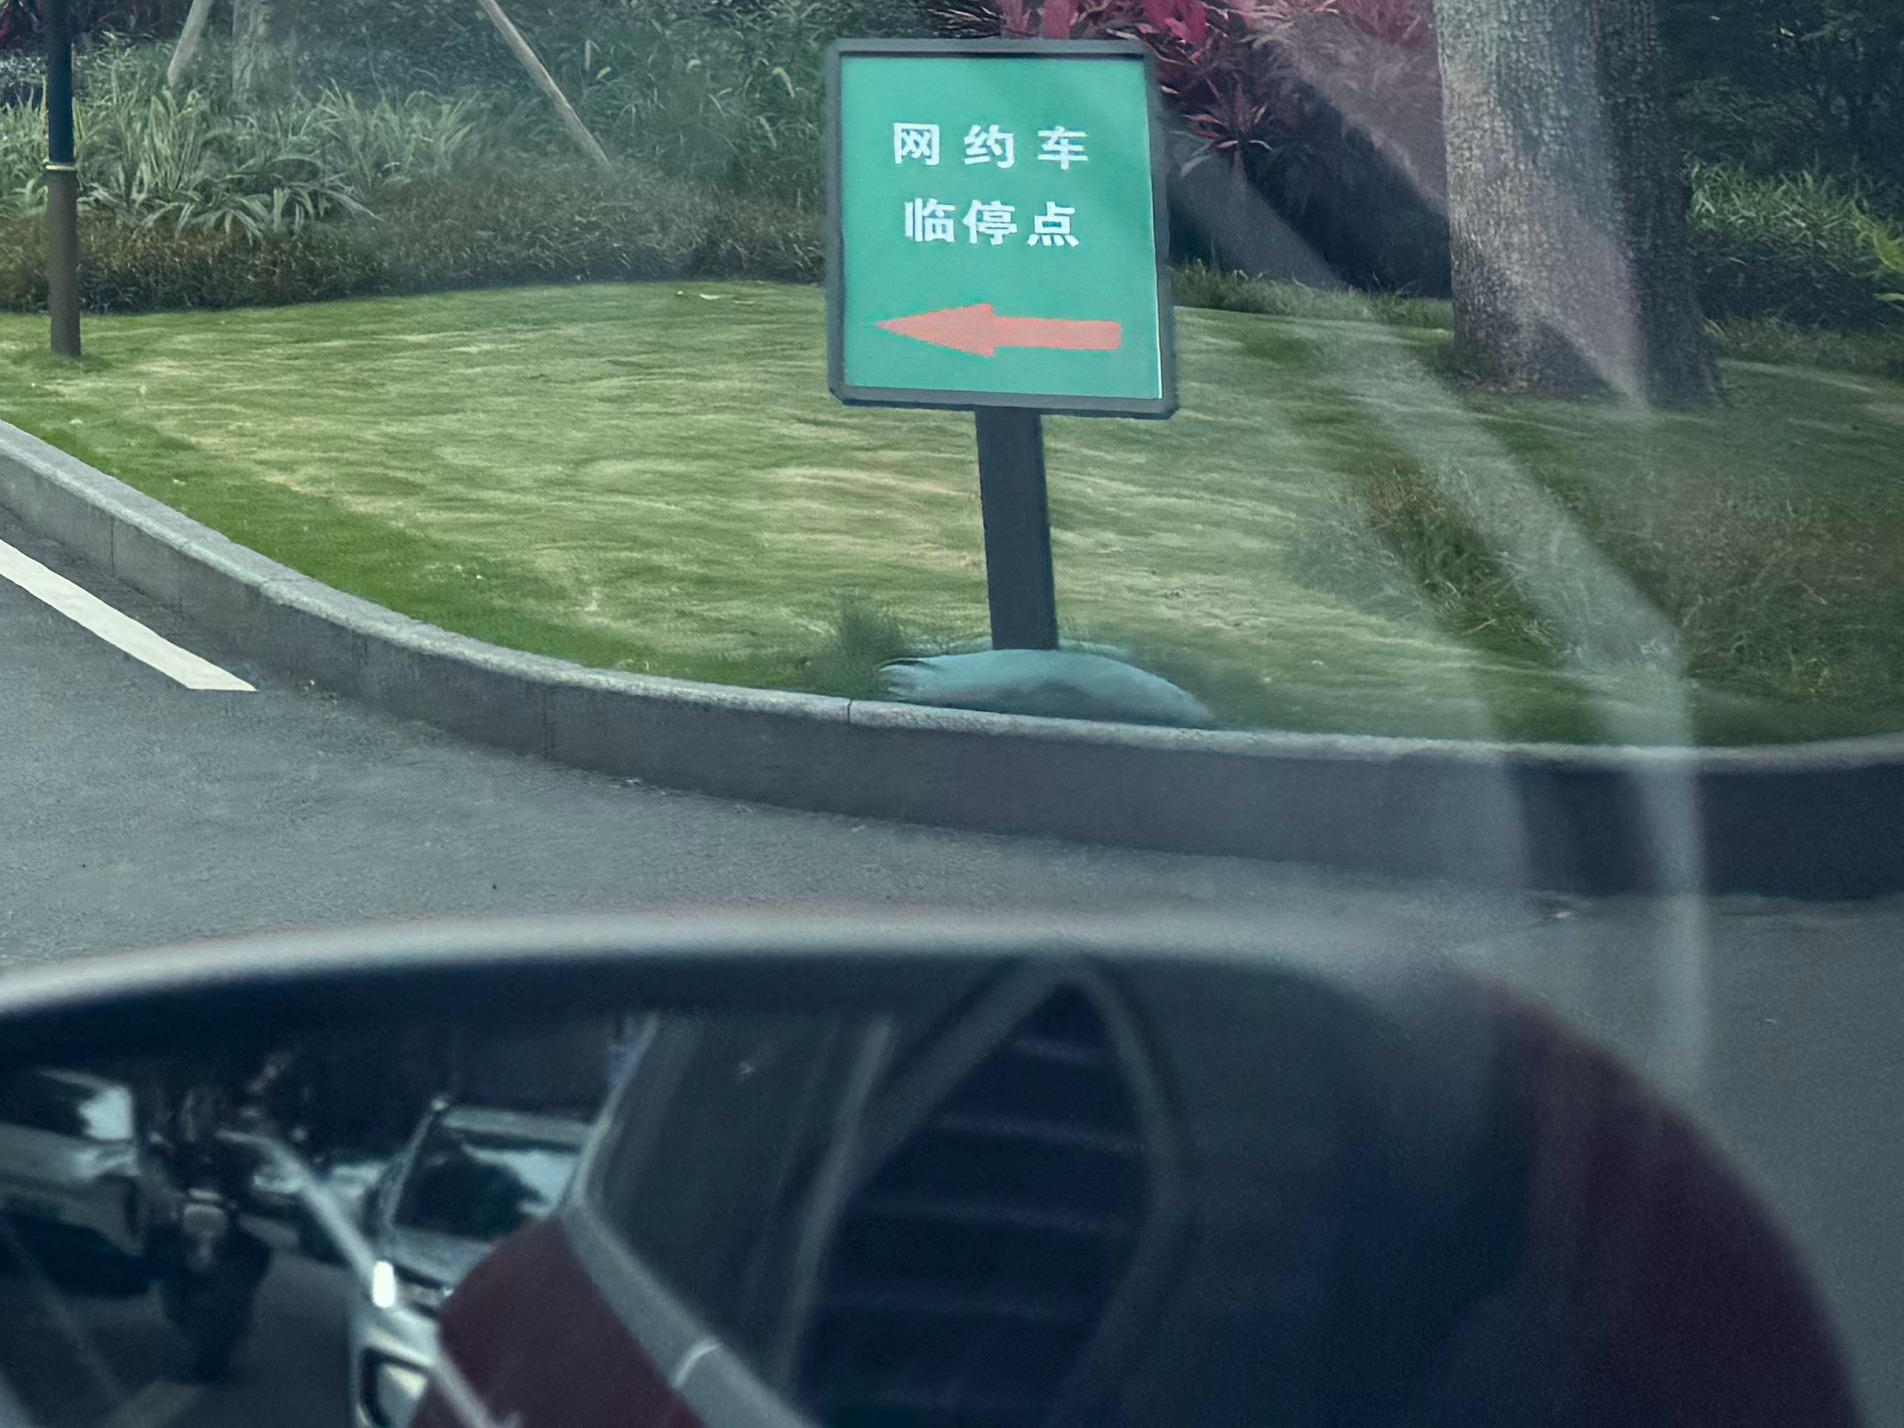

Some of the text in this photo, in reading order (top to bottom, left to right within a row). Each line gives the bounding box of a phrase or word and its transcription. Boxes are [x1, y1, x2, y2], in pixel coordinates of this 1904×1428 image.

[893, 121, 1089, 170] 网约车
[904, 197, 1080, 248] 临停点
